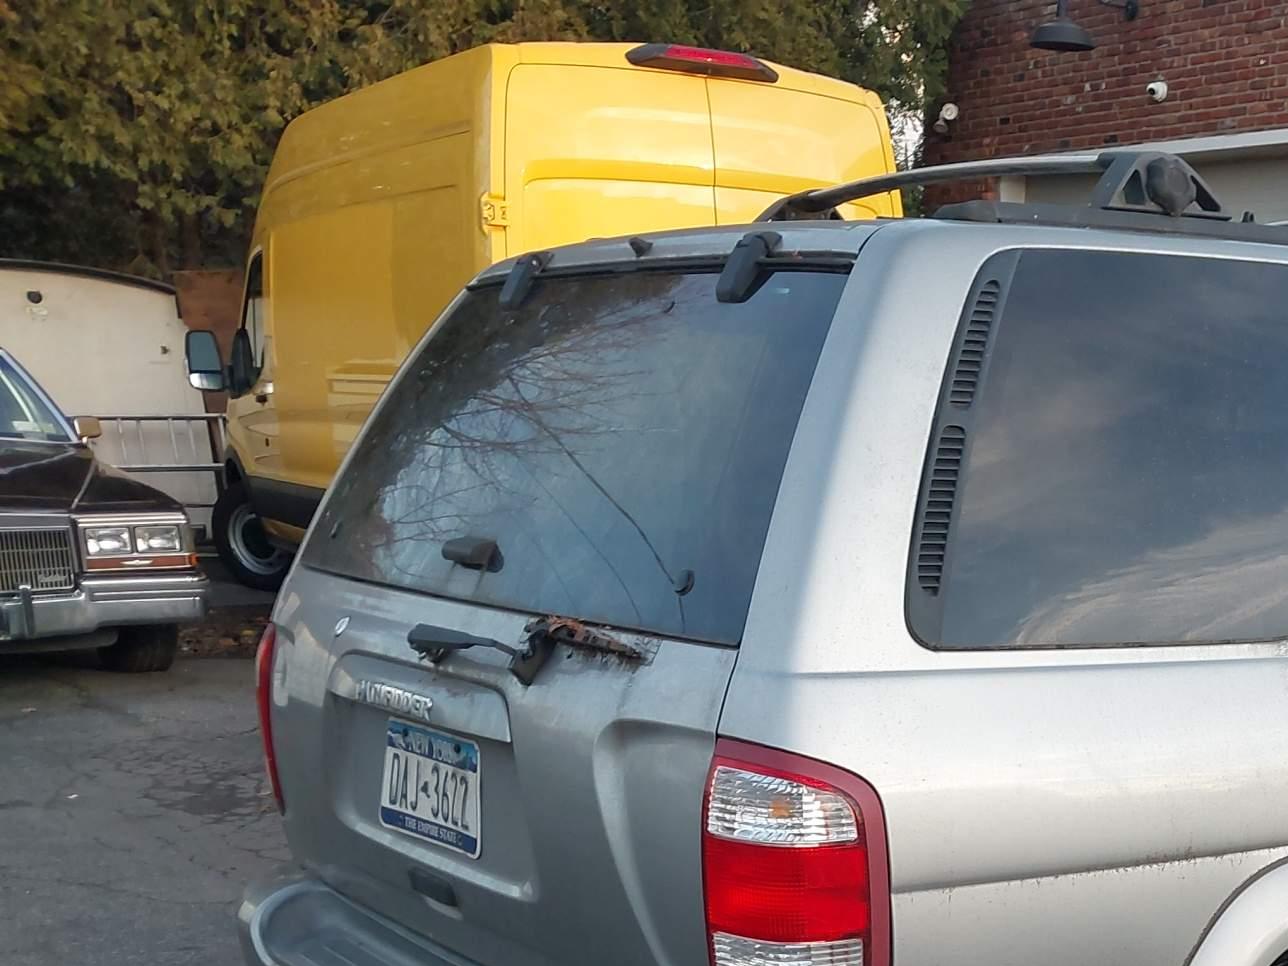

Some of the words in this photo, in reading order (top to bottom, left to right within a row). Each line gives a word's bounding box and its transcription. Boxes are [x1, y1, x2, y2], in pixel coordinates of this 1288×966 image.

[404, 816, 418, 830] THE
[417, 820, 440, 838] EMPIRE
[439, 827, 457, 844] STATE
